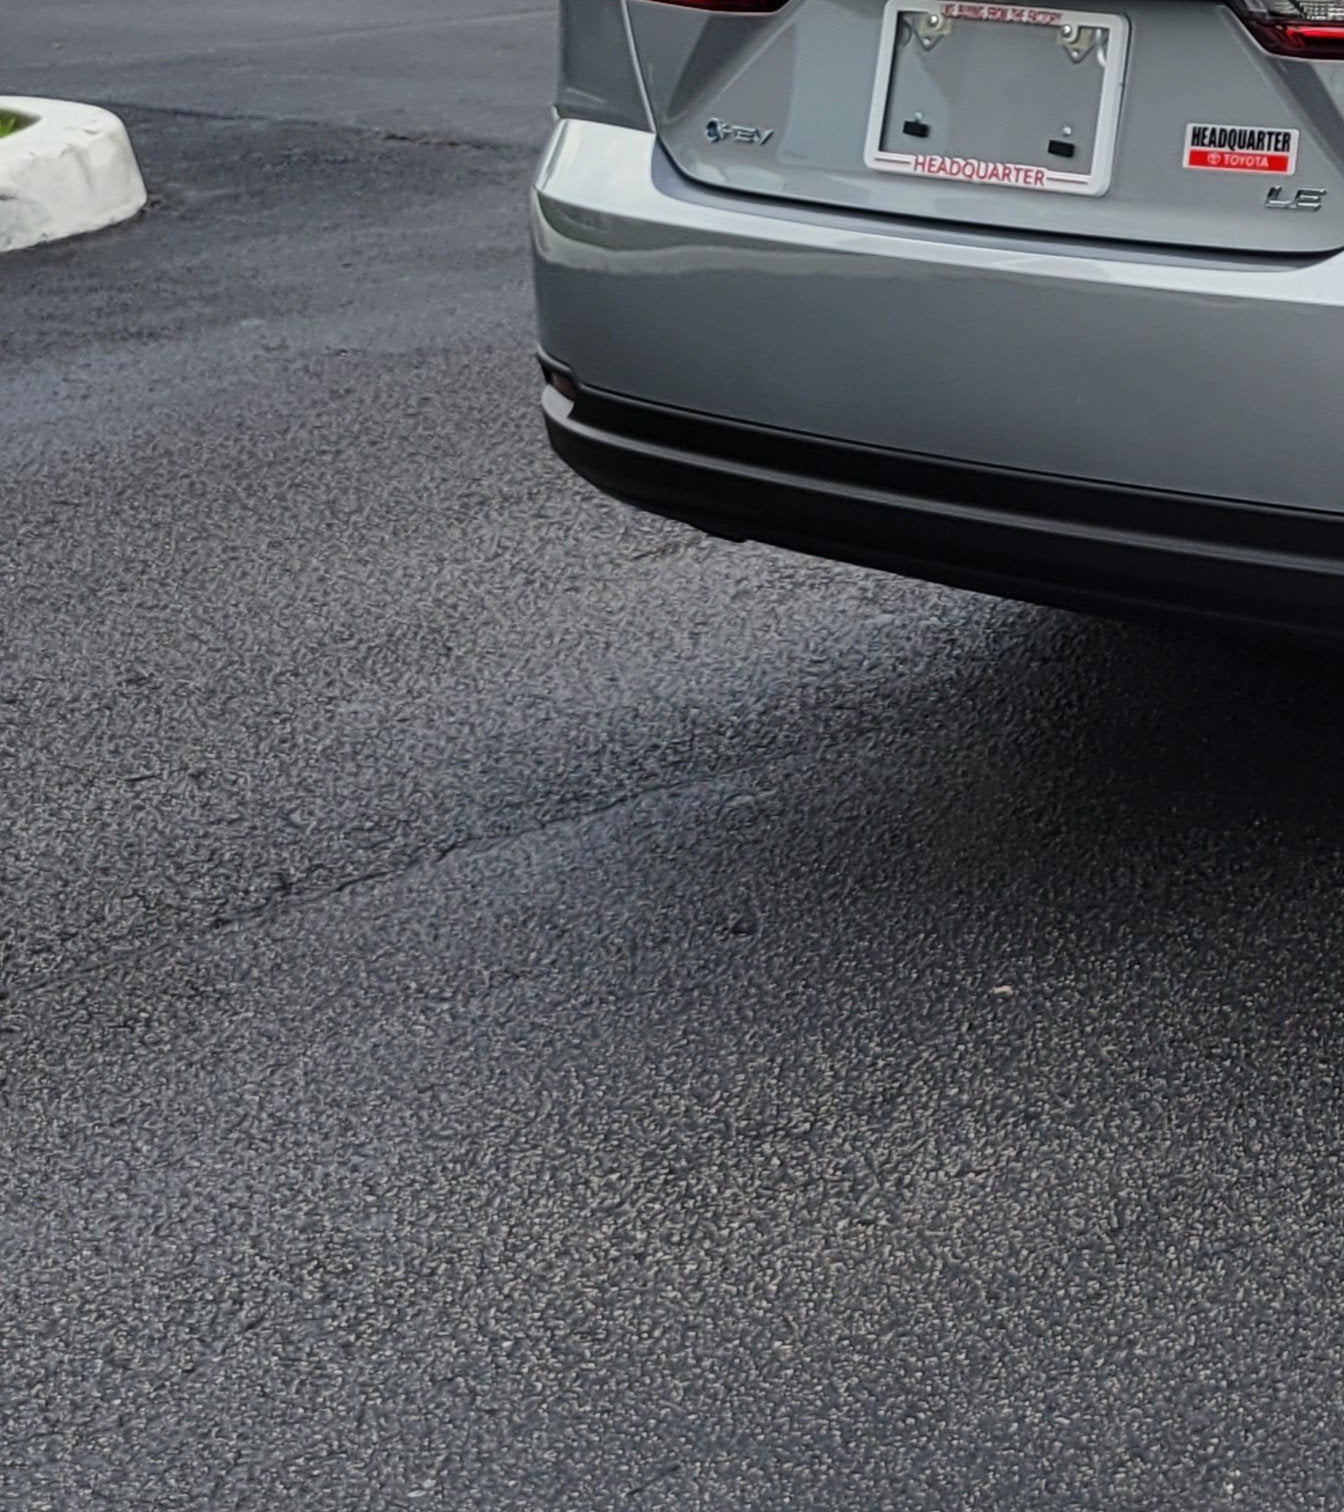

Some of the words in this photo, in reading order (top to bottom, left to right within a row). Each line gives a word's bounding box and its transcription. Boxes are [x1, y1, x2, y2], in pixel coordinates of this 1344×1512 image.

[1191, 126, 1291, 152] HEADQUARTER
[914, 155, 1045, 186] HEADQUARTER
[1223, 154, 1269, 168] TOYOTA
[1264, 185, 1328, 212] LE
